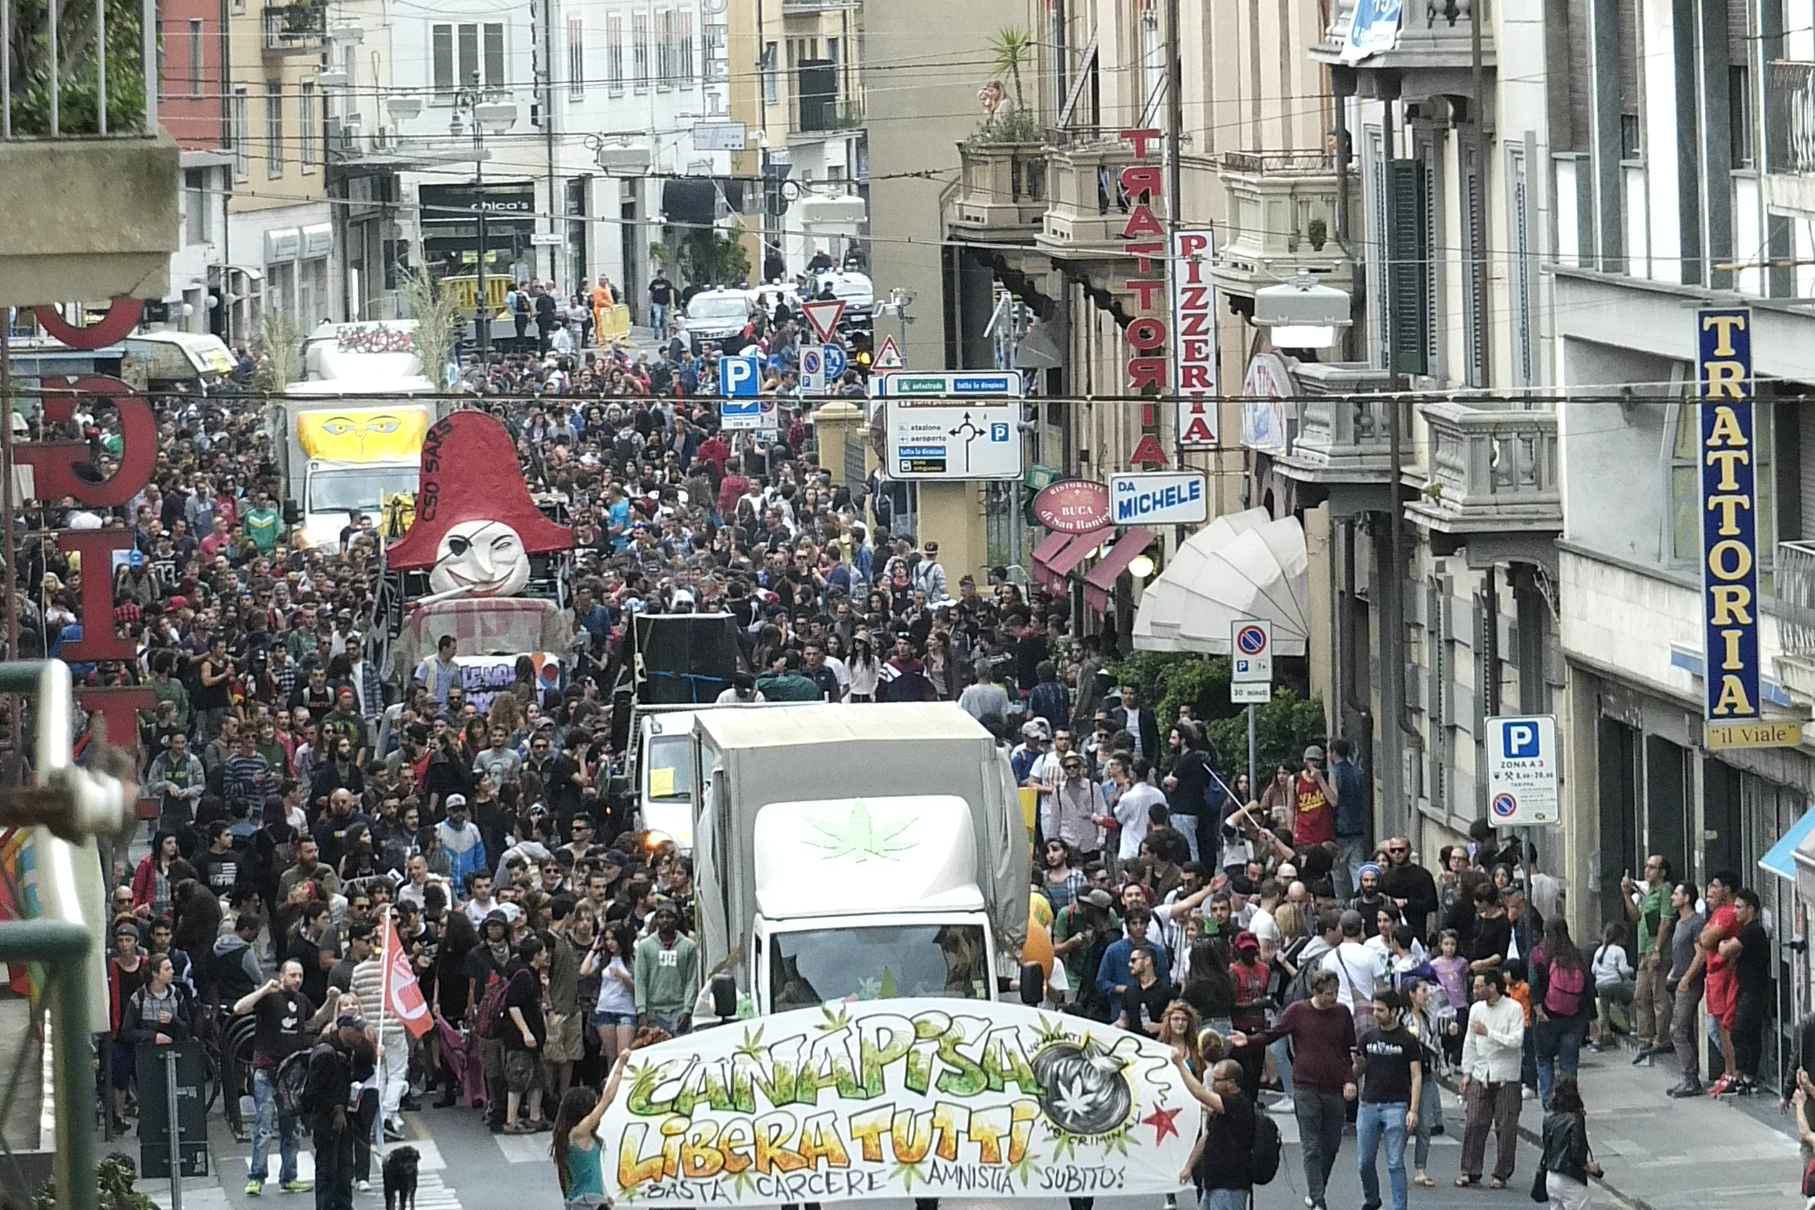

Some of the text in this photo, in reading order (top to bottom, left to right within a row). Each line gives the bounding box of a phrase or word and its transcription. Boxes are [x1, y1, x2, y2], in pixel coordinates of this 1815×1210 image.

[1179, 234, 1214, 441] PIZZERIA
[727, 360, 751, 392] P
[1118, 481, 1136, 491] DA
[1118, 480, 1200, 520] MICHELE
[1061, 505, 1093, 516] BUCA
[1703, 314, 1756, 717] TRATTORIA
[1510, 725, 1532, 754] P
[1501, 761, 1527, 769] ZONA
[1529, 760, 1536, 768] A
[646, 1158, 1126, 1204] BASTA CARCERE AMNISTIA SUBITO!
